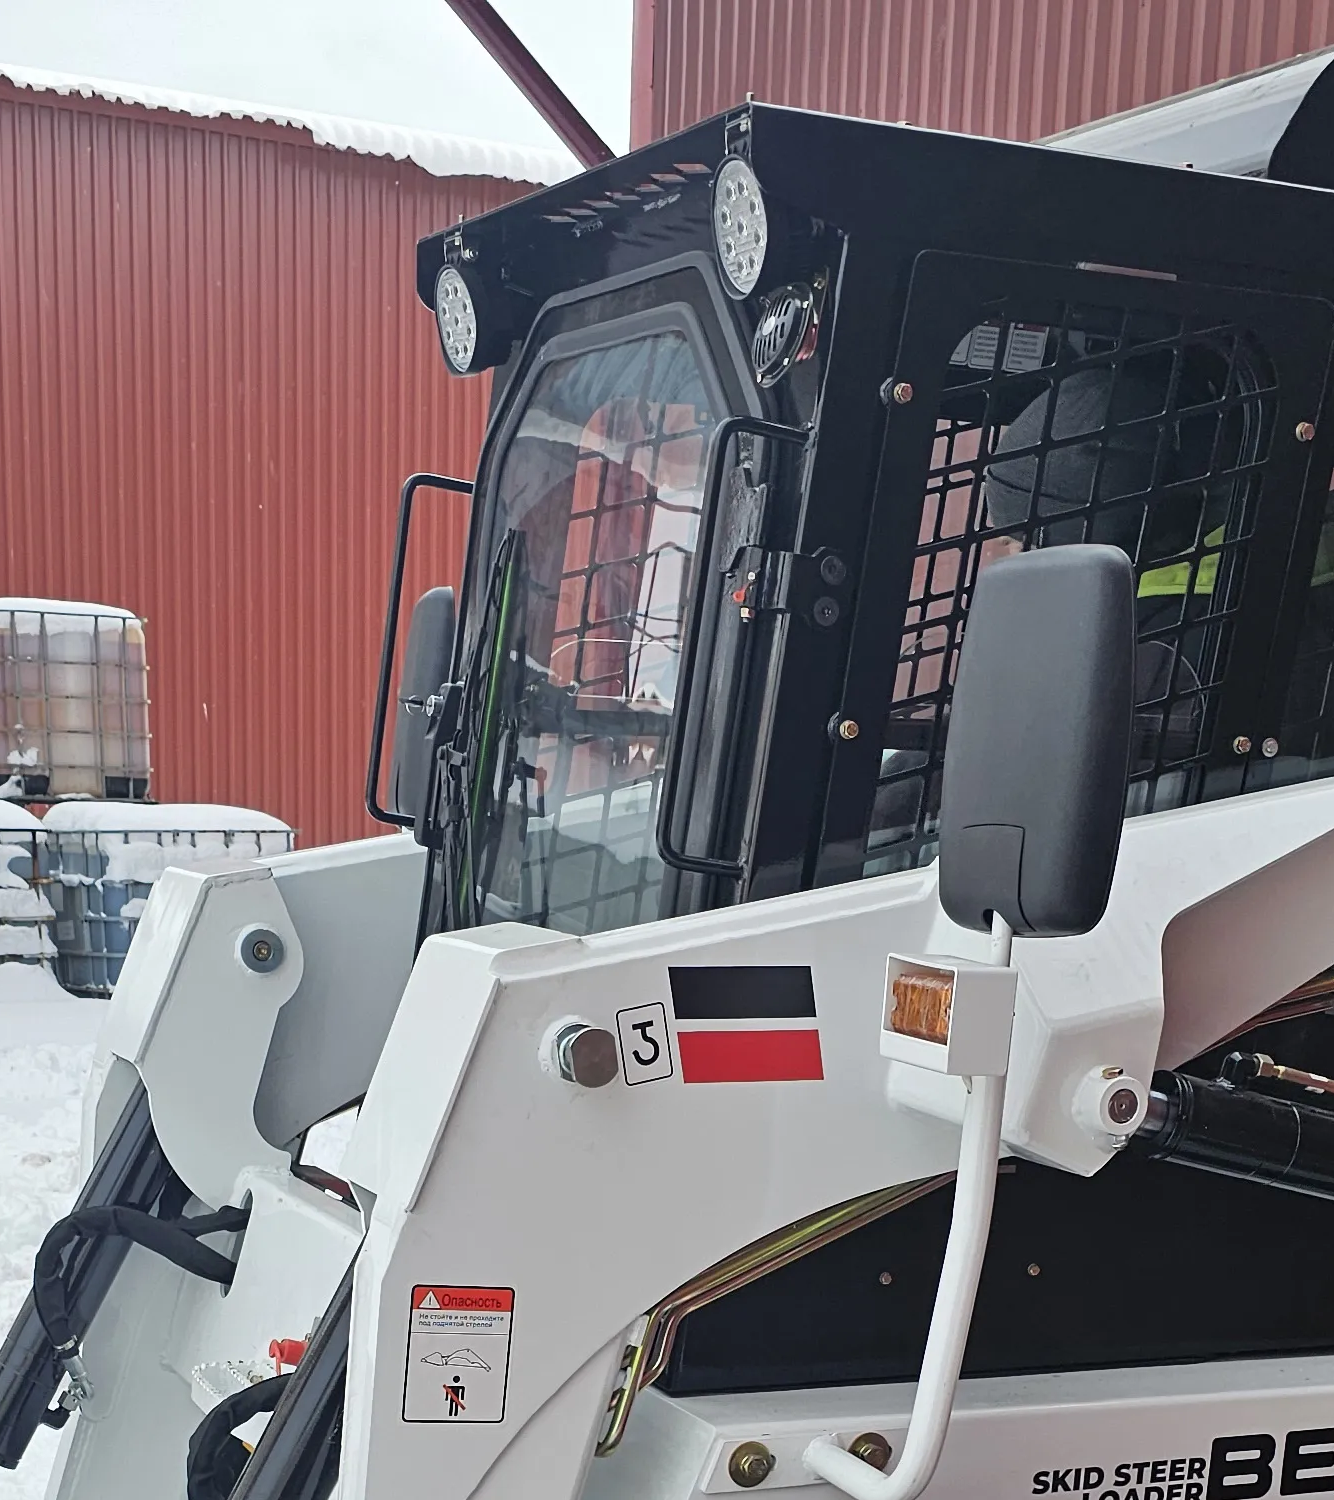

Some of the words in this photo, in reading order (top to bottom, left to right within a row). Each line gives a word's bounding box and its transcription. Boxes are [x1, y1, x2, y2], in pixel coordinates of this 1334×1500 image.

[441, 1294, 502, 1308] Опасность
[1032, 1465, 1105, 1495] SKID
[1112, 1457, 1207, 1487] STEER
